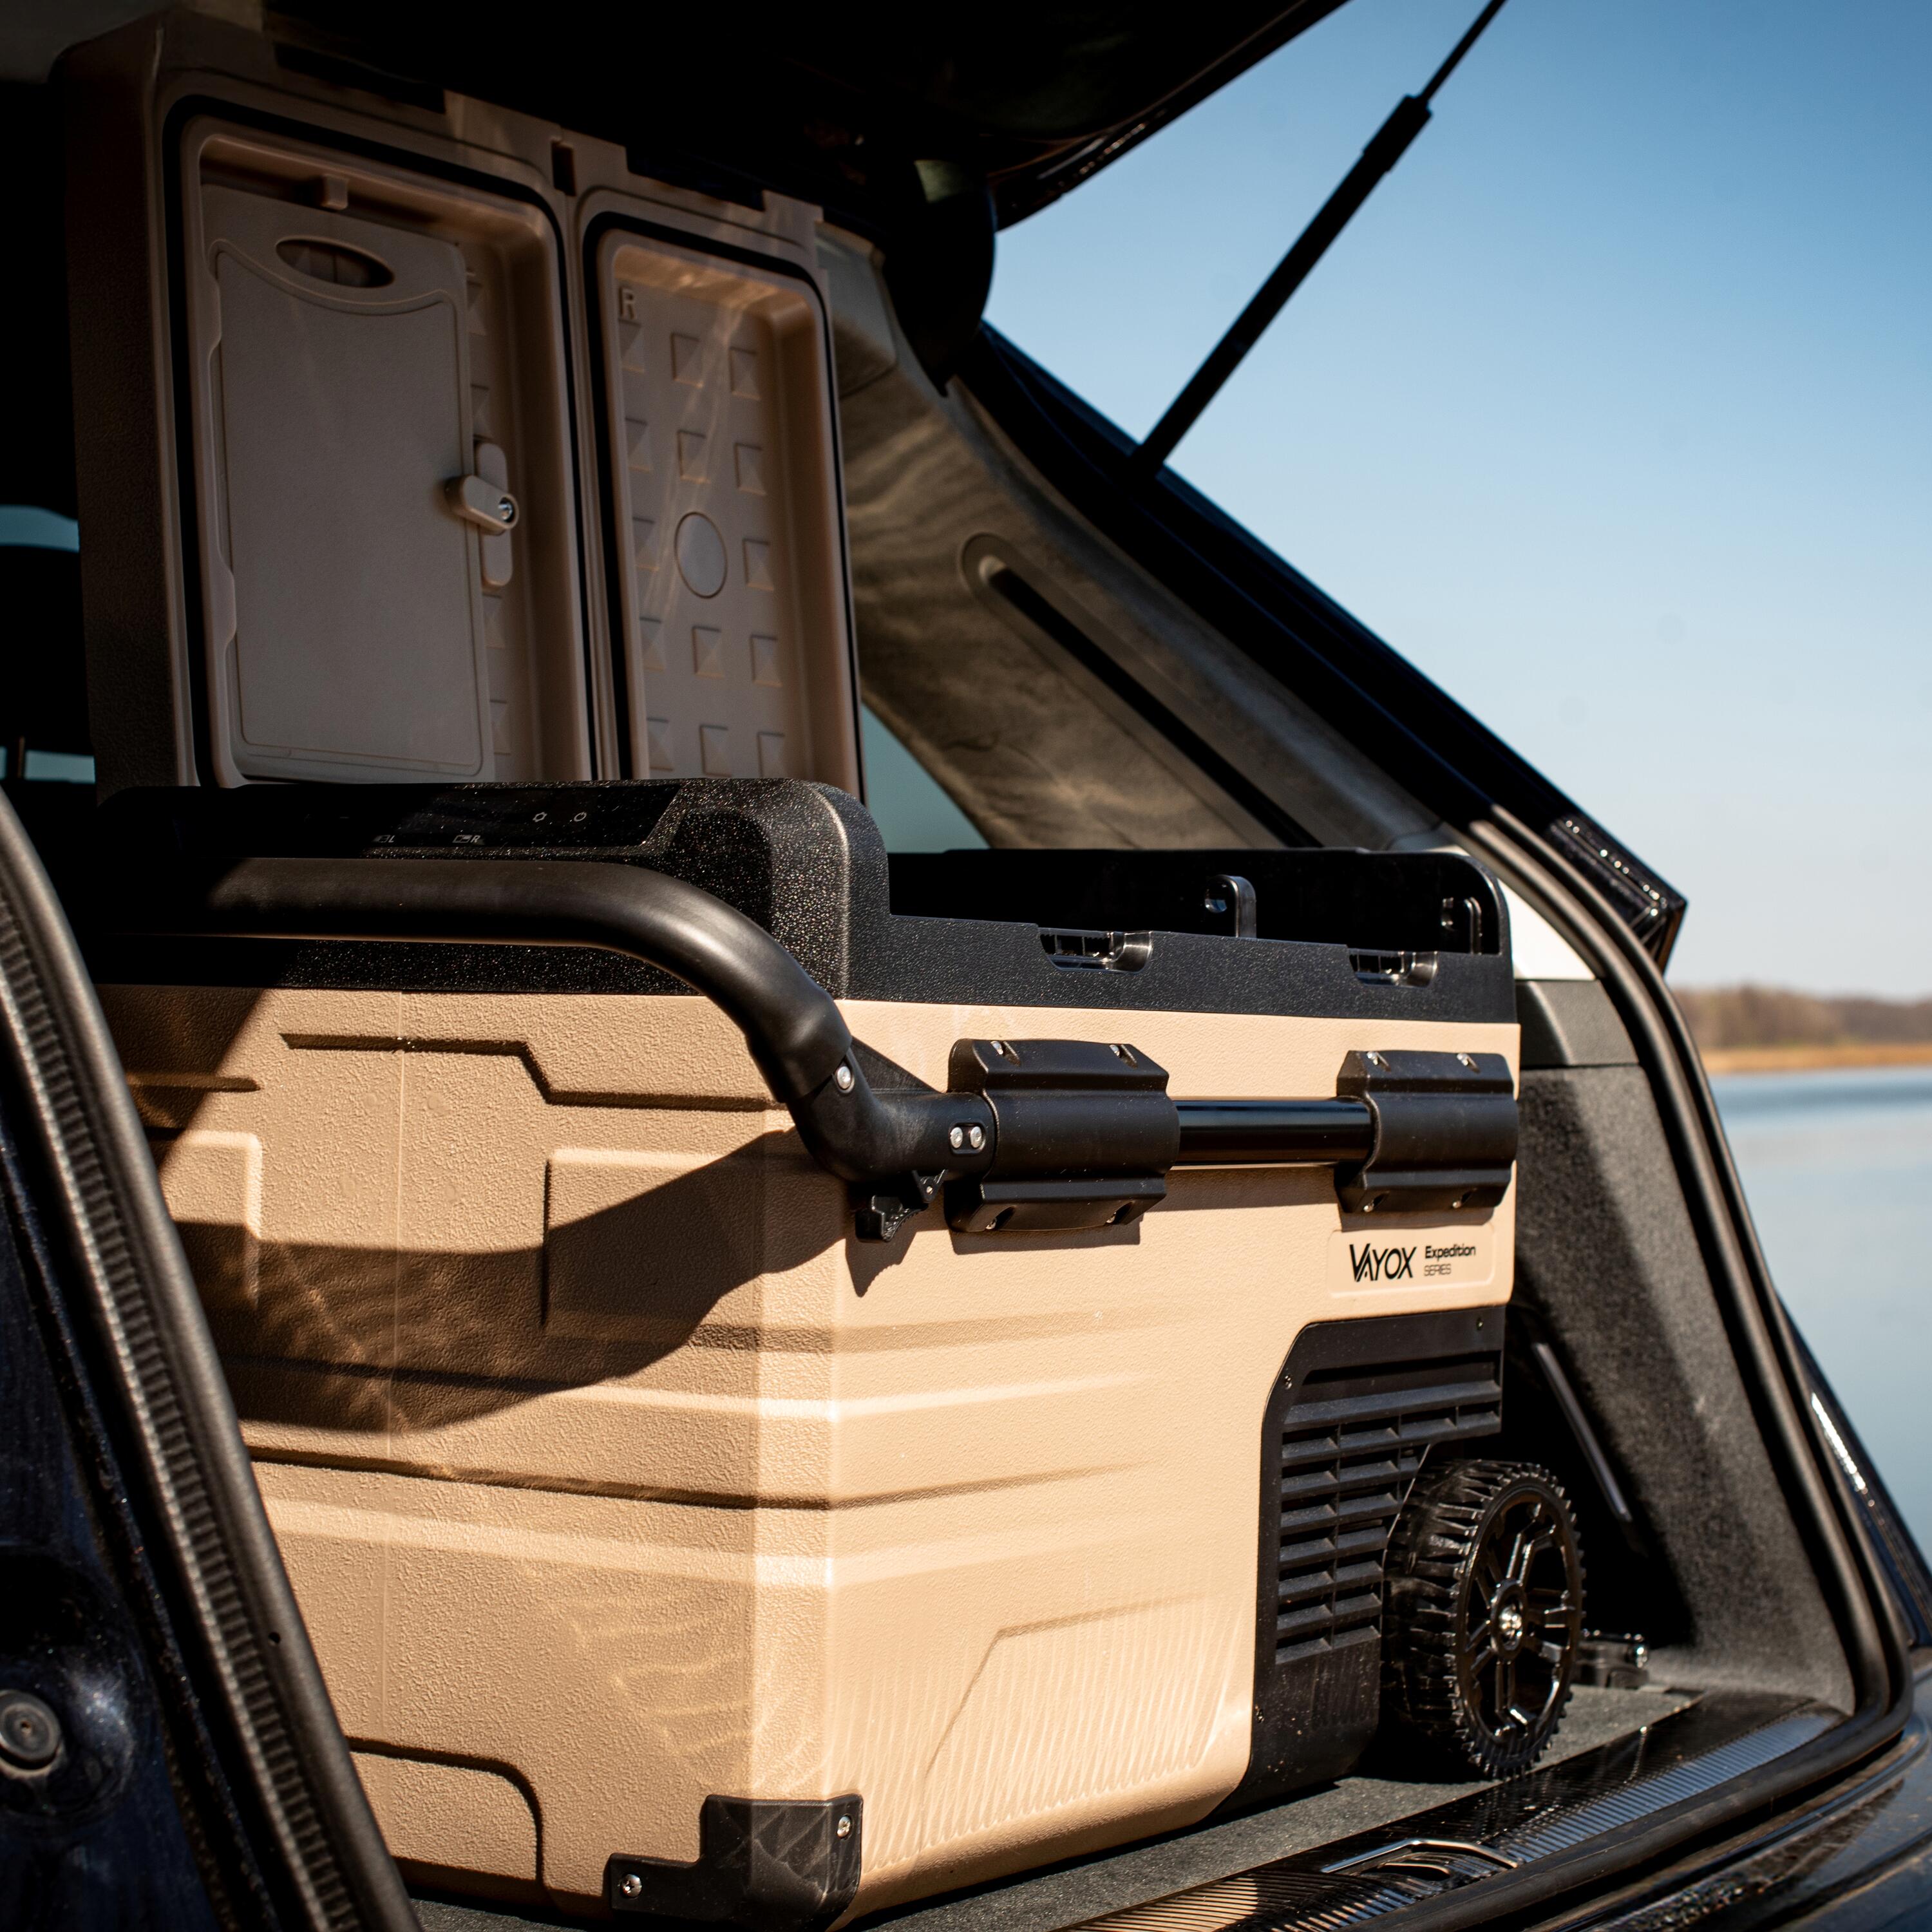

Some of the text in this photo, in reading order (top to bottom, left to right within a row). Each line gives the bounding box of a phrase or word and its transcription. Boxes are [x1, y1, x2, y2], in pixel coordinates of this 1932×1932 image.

[1425, 1244, 1476, 1262] Expedition
[1349, 1243, 1417, 1282] VAYOX
[1424, 1264, 1452, 1276] SERIES
